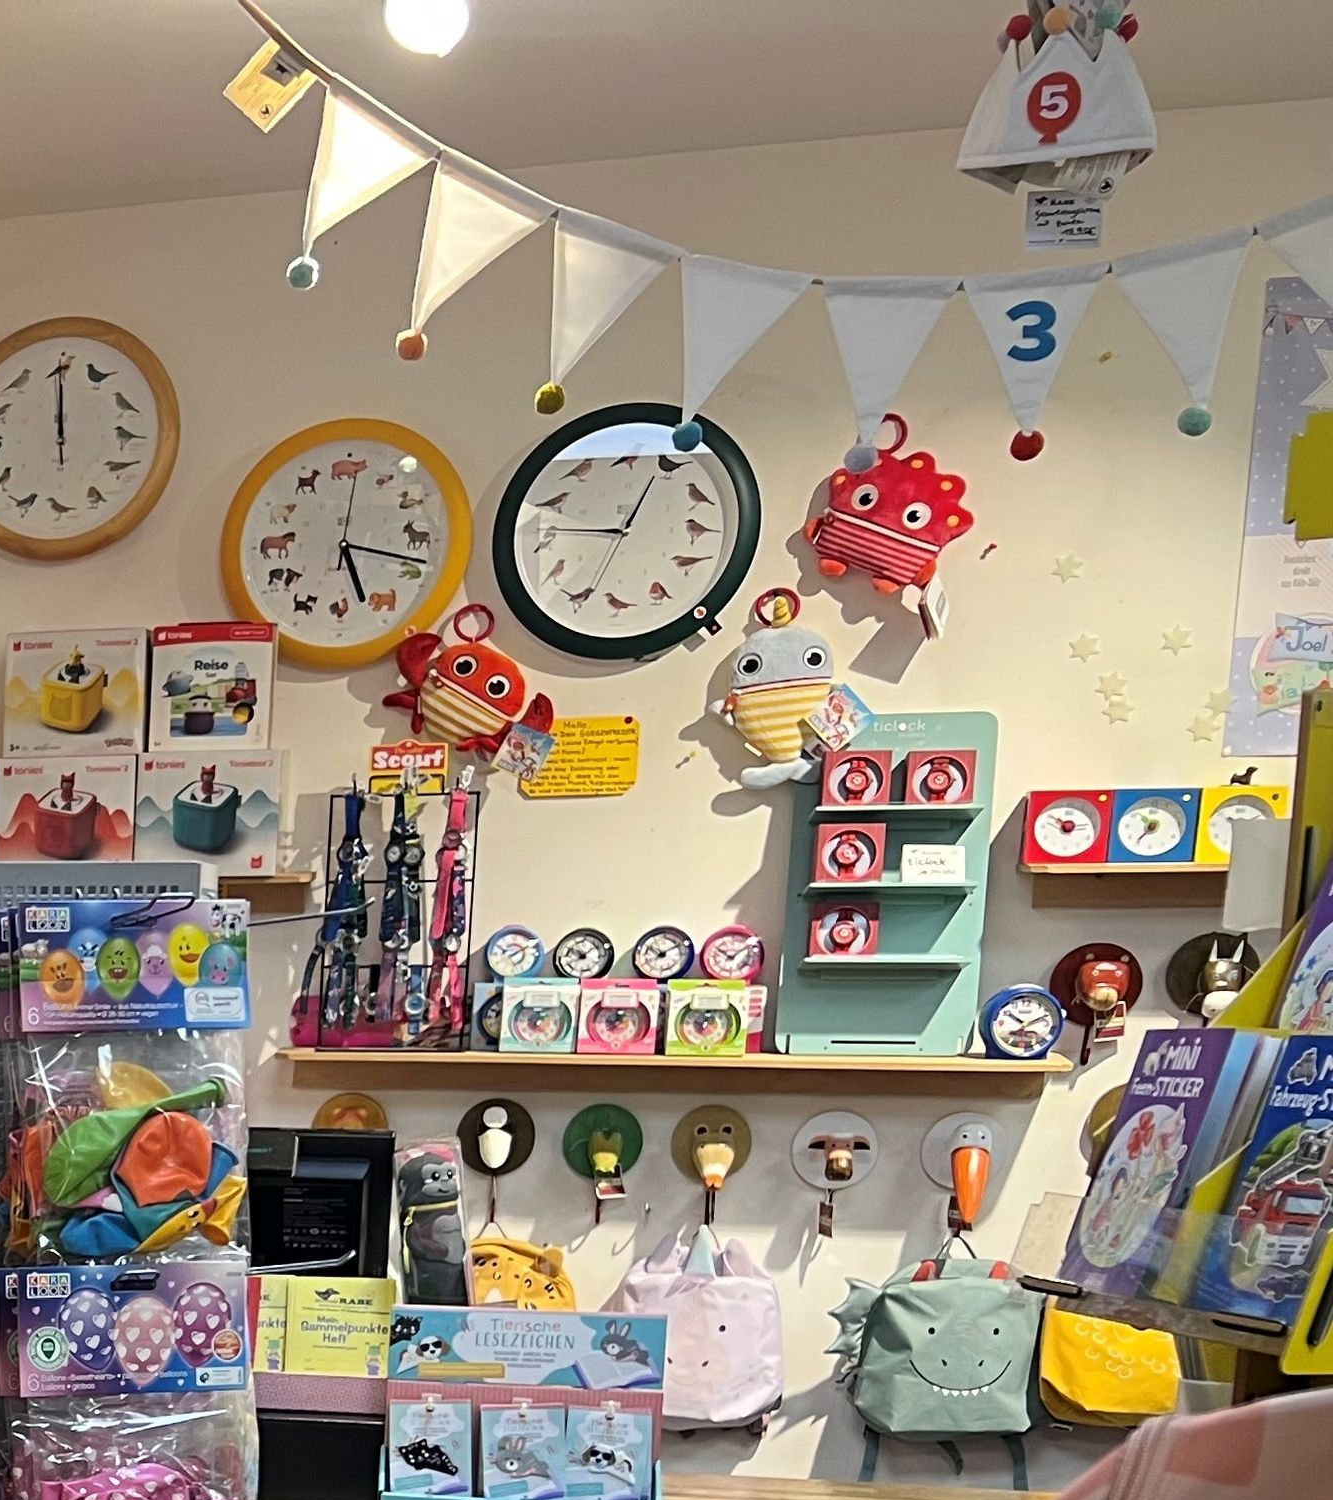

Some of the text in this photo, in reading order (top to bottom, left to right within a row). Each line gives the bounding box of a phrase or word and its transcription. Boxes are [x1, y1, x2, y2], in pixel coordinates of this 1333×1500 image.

[1041, 84, 1069, 119] 5
[1007, 301, 1056, 362] 3
[194, 659, 229, 672] Reise
[874, 719, 926, 732] ticlock
[373, 751, 446, 770] Scout
[490, 1317, 562, 1333] Tierische
[474, 1333, 575, 1350] LESEZEICHEN
